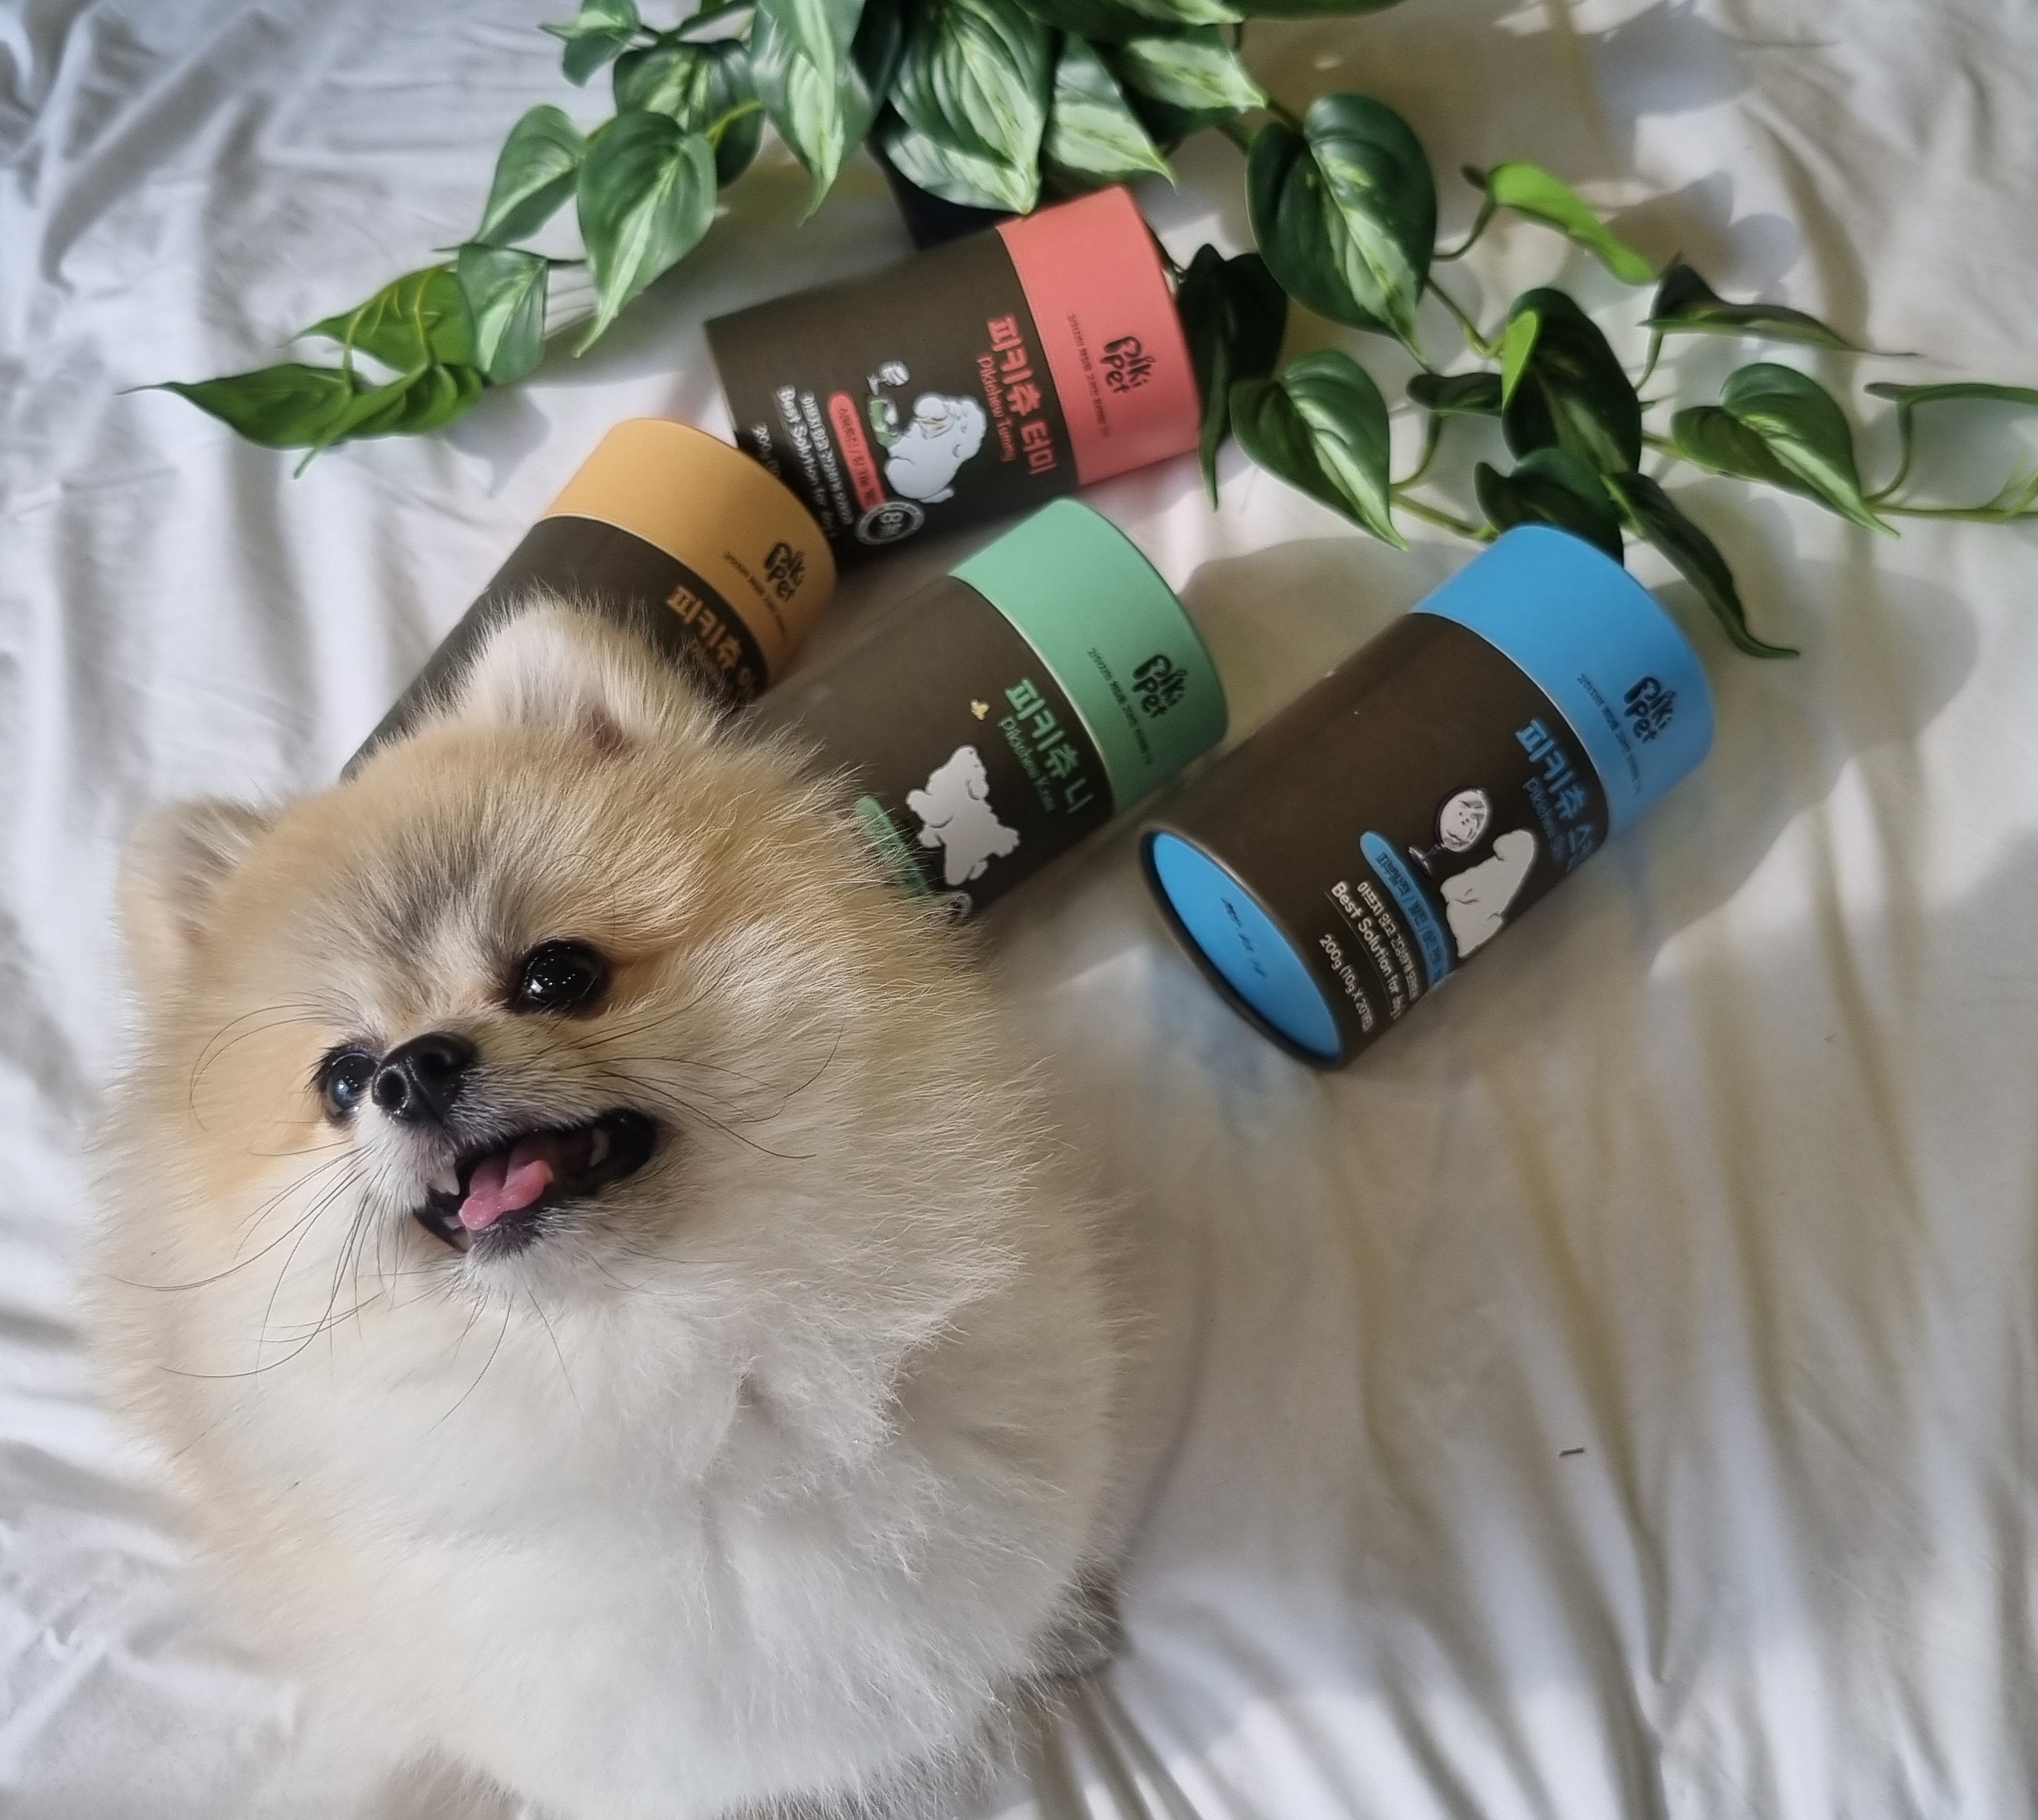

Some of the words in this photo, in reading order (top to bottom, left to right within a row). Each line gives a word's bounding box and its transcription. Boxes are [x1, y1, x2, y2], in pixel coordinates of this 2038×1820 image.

[777, 387, 802, 424] Best
[987, 316, 1041, 416] 피키츄
[1019, 420, 1056, 474] 터미
[788, 422, 819, 485] Solution
[666, 586, 741, 672] 피키츄
[1004, 678, 1078, 777] 피키츄
[1515, 718, 1586, 819] 피키츄
[1319, 933, 1343, 971] 200g
[1338, 965, 1357, 994] (10g
[1331, 880, 1363, 920] Best
[1357, 916, 1393, 977] Solution
[1386, 973, 1401, 994] for
[1357, 881, 1385, 916] 아프지
[1377, 912, 1397, 937] 않고
[1389, 932, 1414, 974] 건강하게
